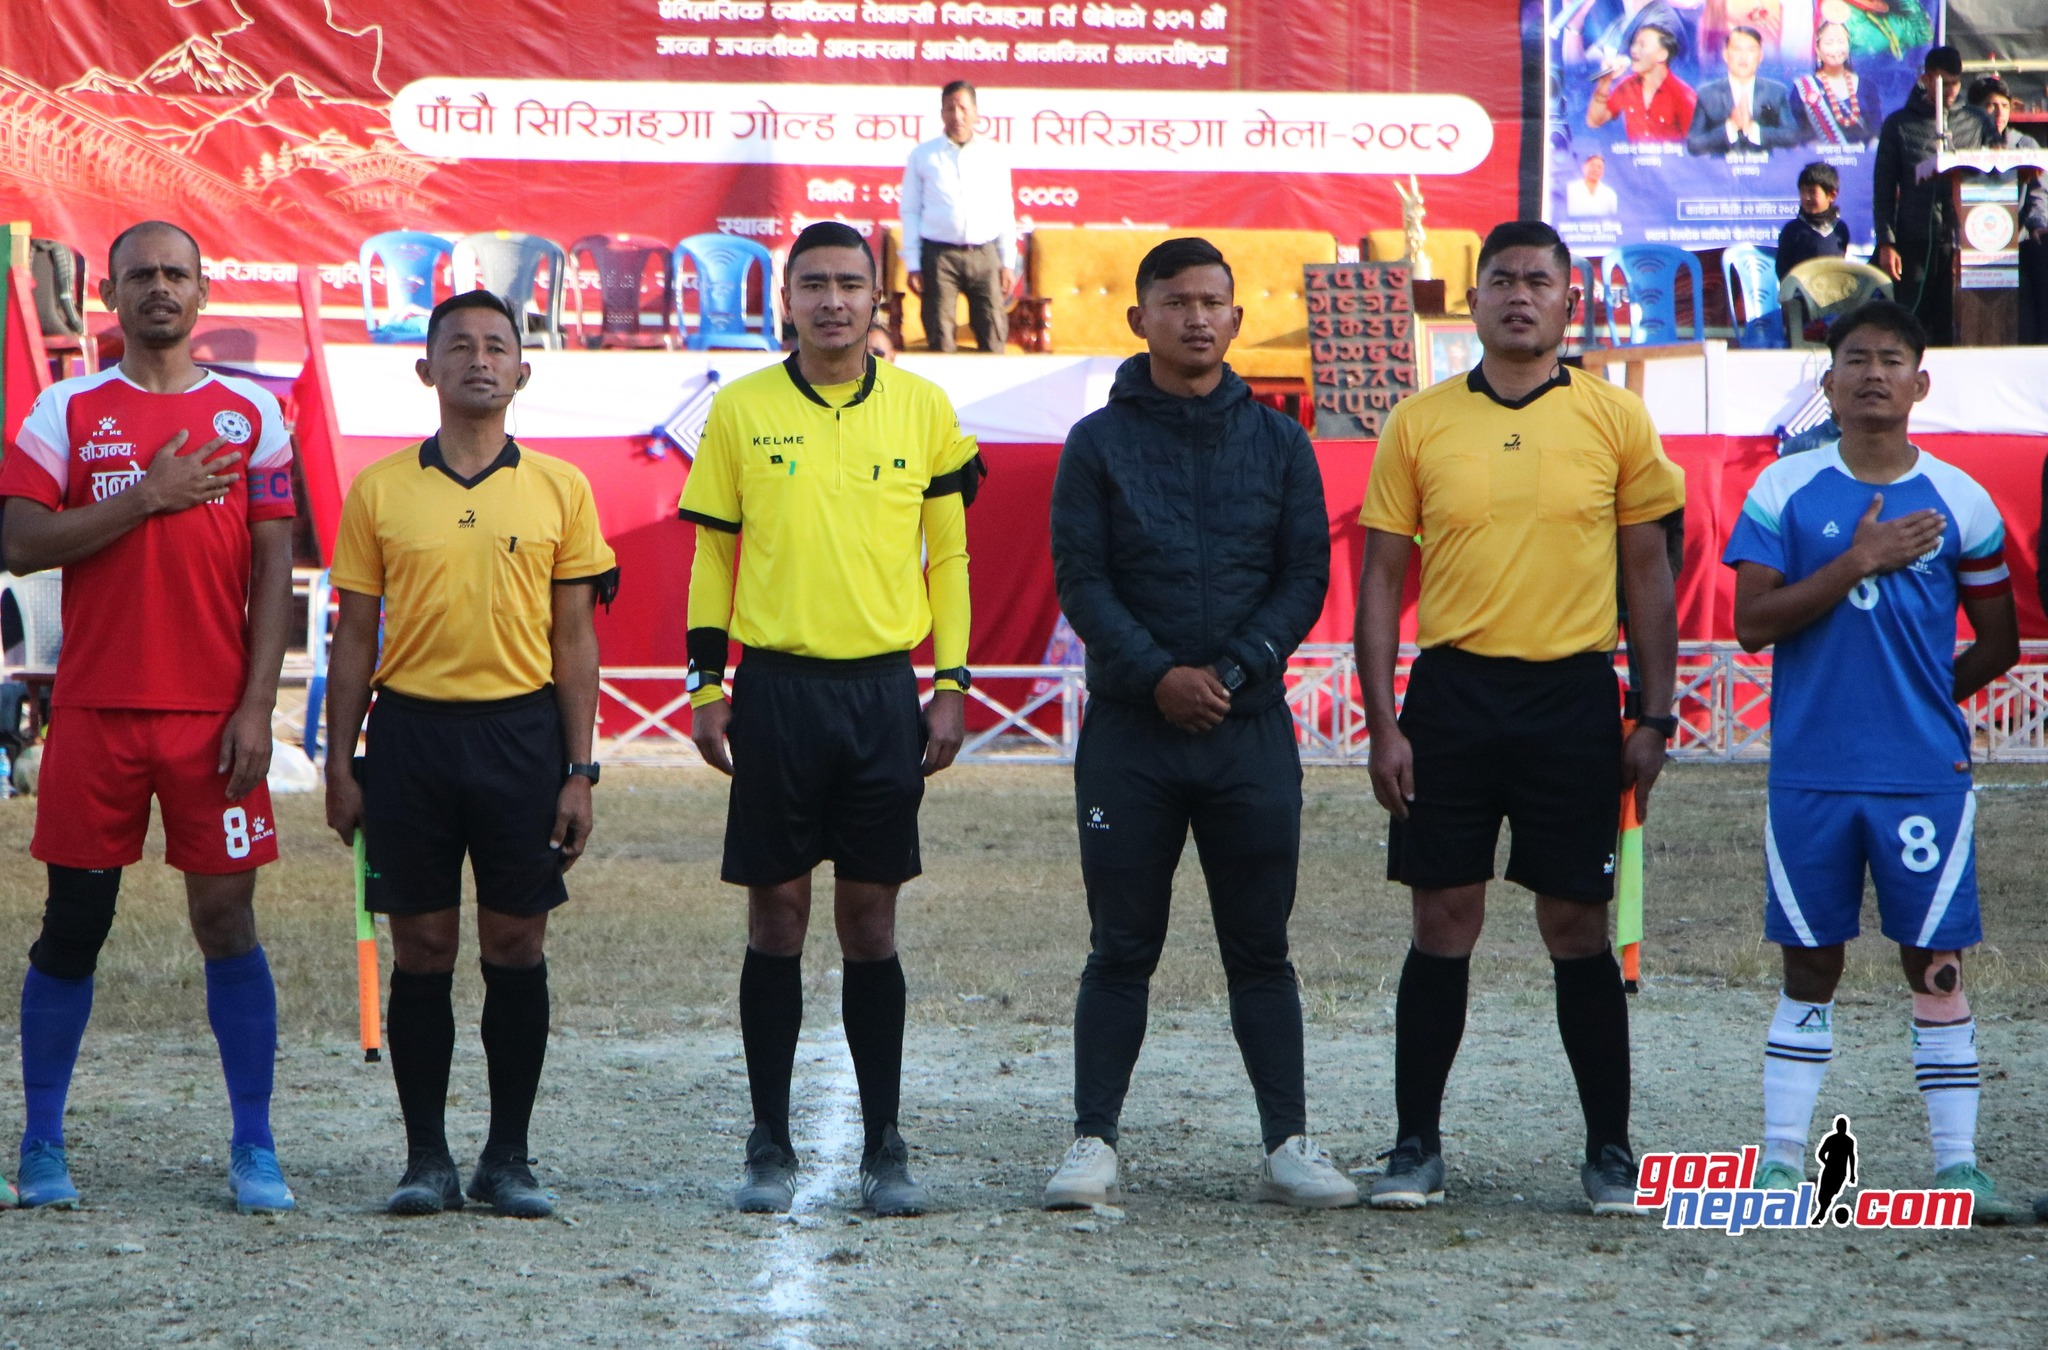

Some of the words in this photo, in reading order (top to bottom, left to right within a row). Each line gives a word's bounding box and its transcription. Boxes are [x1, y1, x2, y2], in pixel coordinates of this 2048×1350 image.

[656, 36, 711, 56] जन्म
[715, 33, 820, 58] जयन्तीको
[823, 38, 917, 60] अवसरमा
[922, 35, 1009, 62] आयोजित
[516, 99, 715, 146] सिरिजङ्गा
[731, 99, 836, 142] गोल्ड
[855, 111, 926, 143] कप
[1031, 109, 1228, 154] सिरिजङ्गा
[1018, 186, 1080, 207] २०८२
[753, 436, 804, 446] KELME
[222, 806, 251, 859] 8
[251, 828, 275, 842] KELME
[1898, 815, 1940, 873] 8
